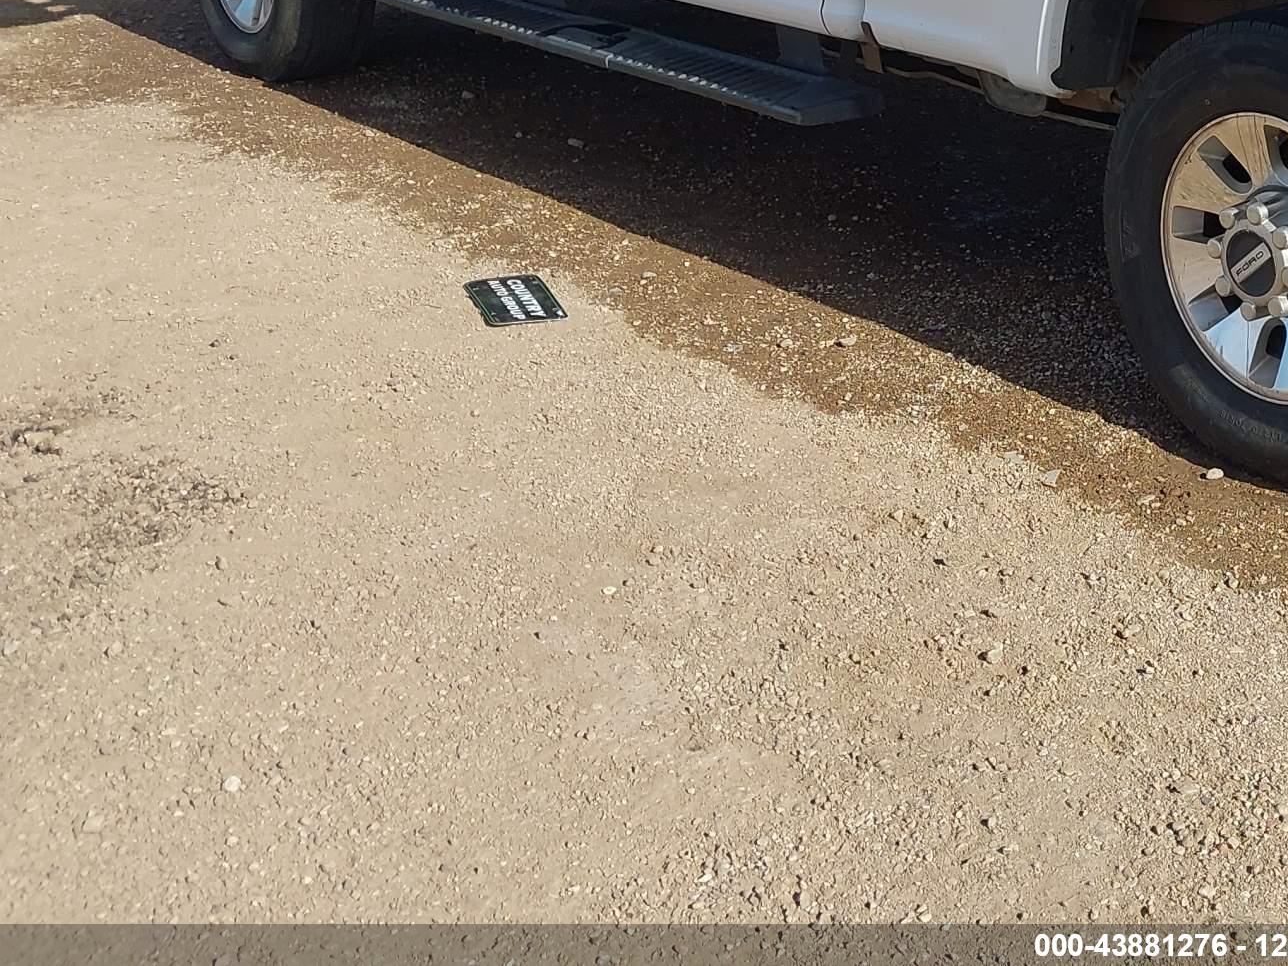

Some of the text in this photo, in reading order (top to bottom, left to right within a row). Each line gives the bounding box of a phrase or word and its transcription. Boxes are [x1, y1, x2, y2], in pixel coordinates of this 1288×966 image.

[1236, 250, 1264, 276] FORD
[487, 280, 527, 320] AUTO GROUP
[506, 279, 546, 317] COUNTRY
